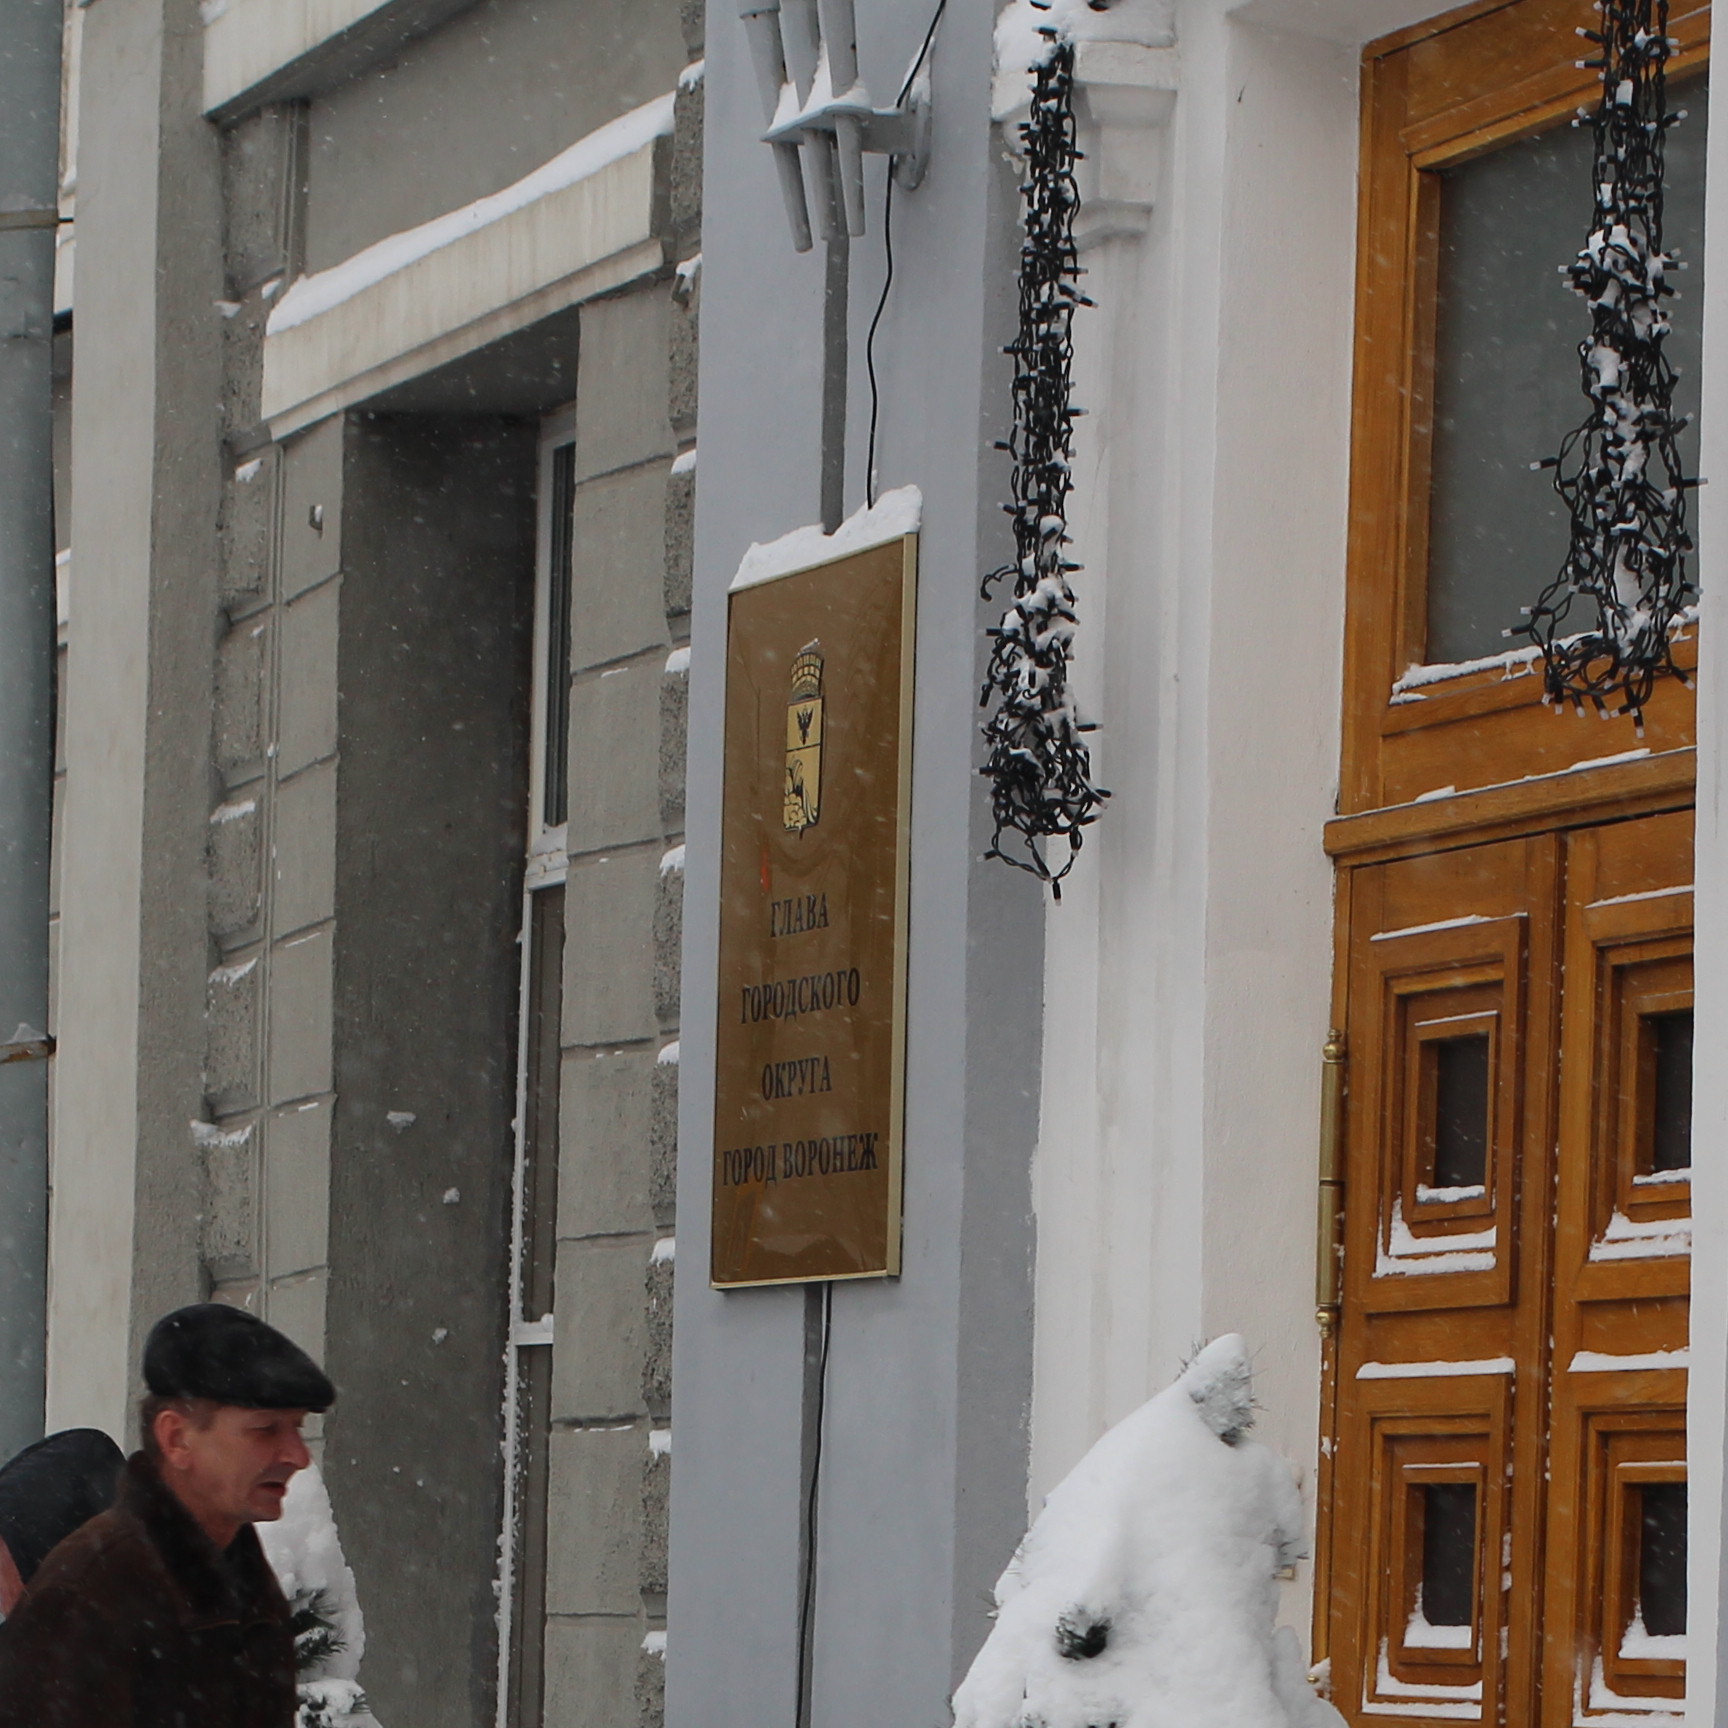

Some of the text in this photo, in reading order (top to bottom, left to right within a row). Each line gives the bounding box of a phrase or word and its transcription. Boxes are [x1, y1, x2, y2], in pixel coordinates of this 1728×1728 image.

[770, 892, 829, 938] ГЛАВА
[740, 967, 860, 1025] ГОРОДСКОГО
[761, 1055, 832, 1101] ОКРУГА
[722, 1132, 878, 1187] ГОРОД ВОРОНЕЖ
